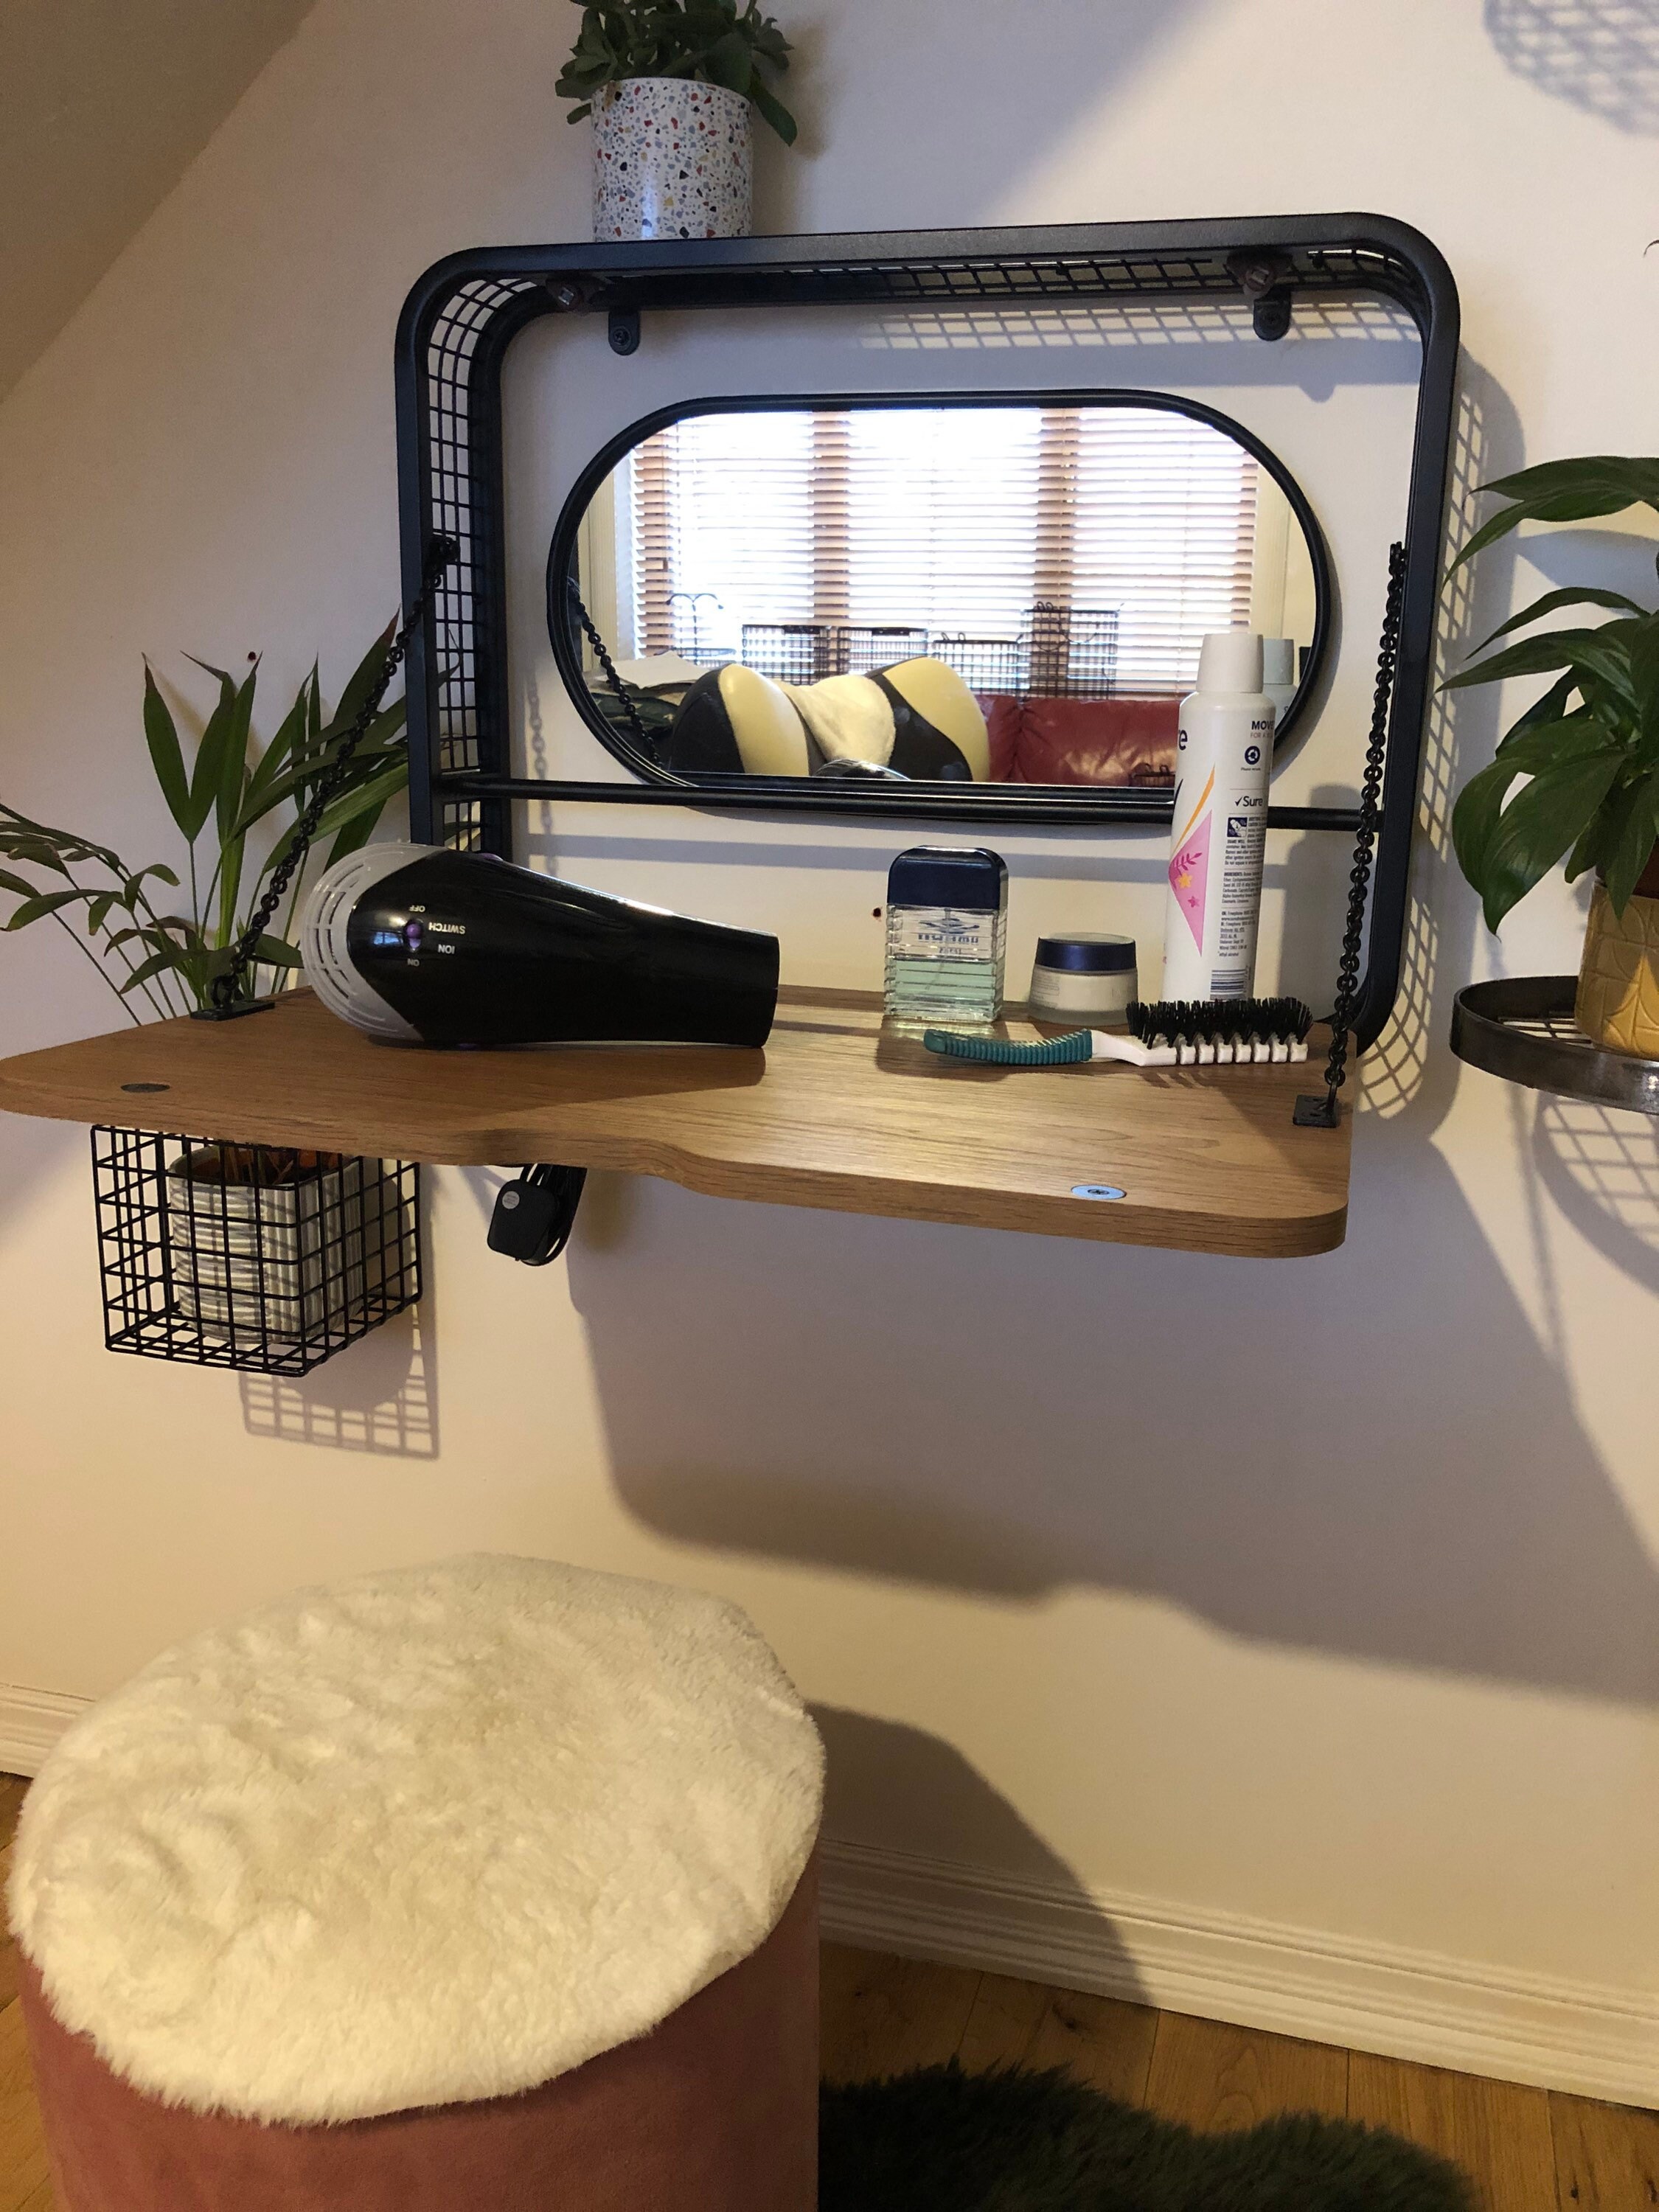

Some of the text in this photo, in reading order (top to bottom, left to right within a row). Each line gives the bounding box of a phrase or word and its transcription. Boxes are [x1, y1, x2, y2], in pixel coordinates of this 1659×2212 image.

[1179, 729, 1188, 751] e
[1242, 796, 1263, 807] Sure
[428, 922, 466, 934] SWITCH
[438, 944, 455, 954] ION
